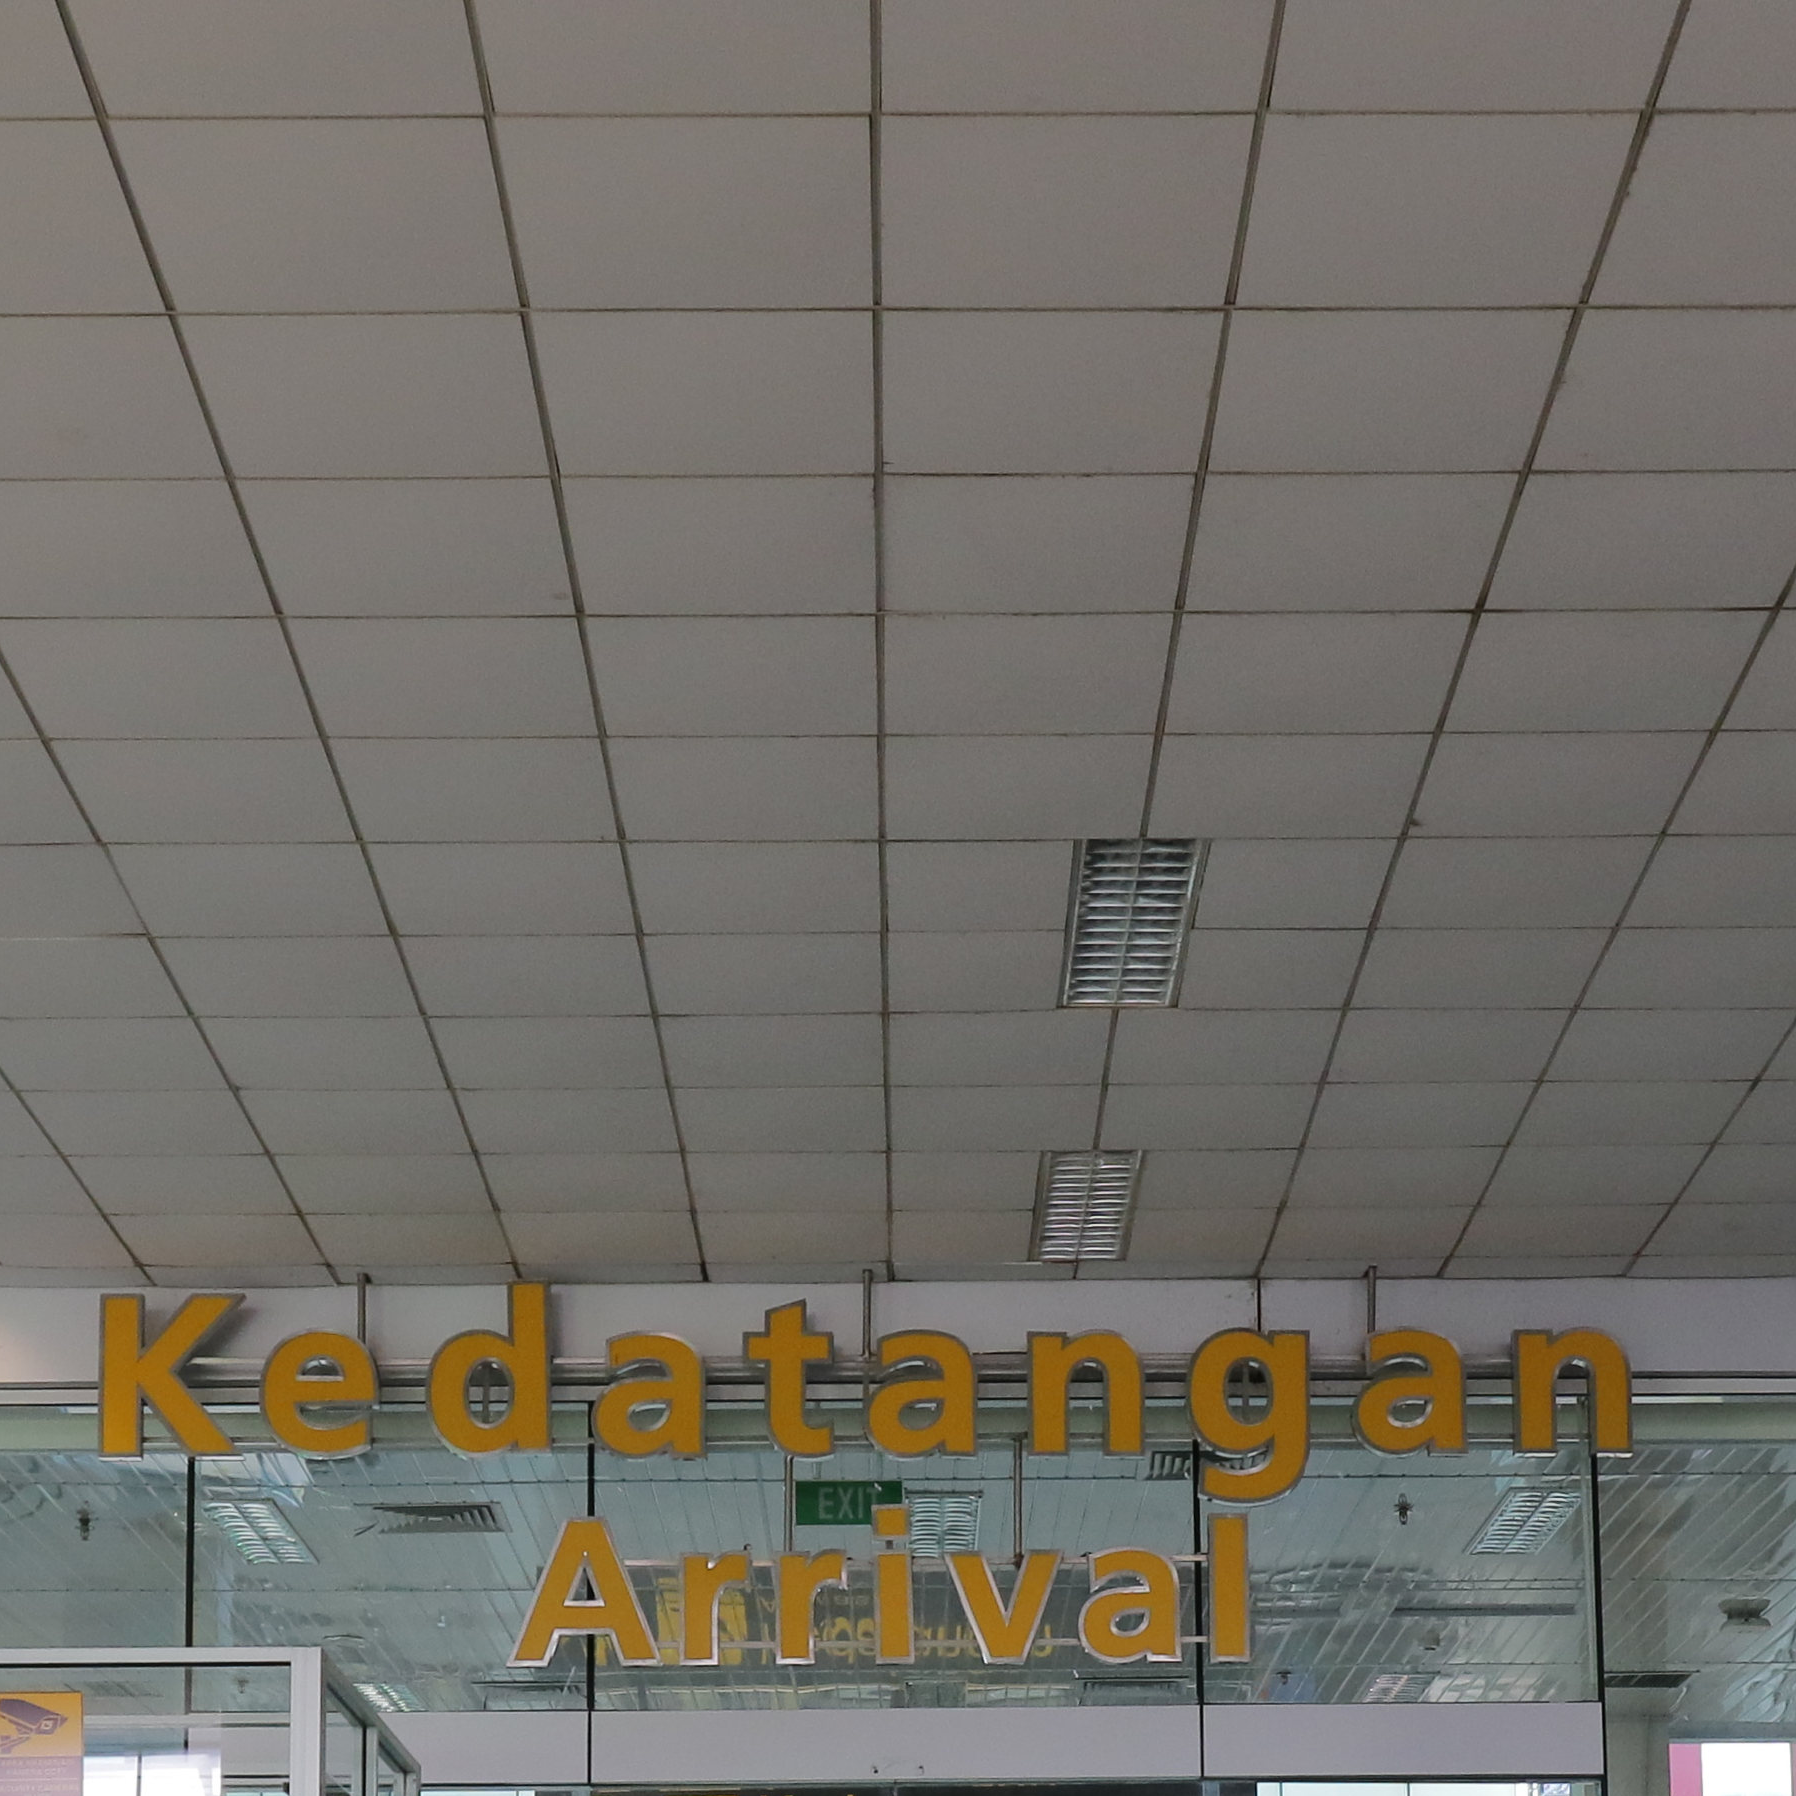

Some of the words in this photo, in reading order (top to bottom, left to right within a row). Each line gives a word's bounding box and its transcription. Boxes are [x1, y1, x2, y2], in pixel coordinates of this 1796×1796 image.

[96, 1281, 1635, 1502] Kedatangan
[505, 1503, 1255, 1669] Arrival
[818, 1487, 879, 1519] EXIT
